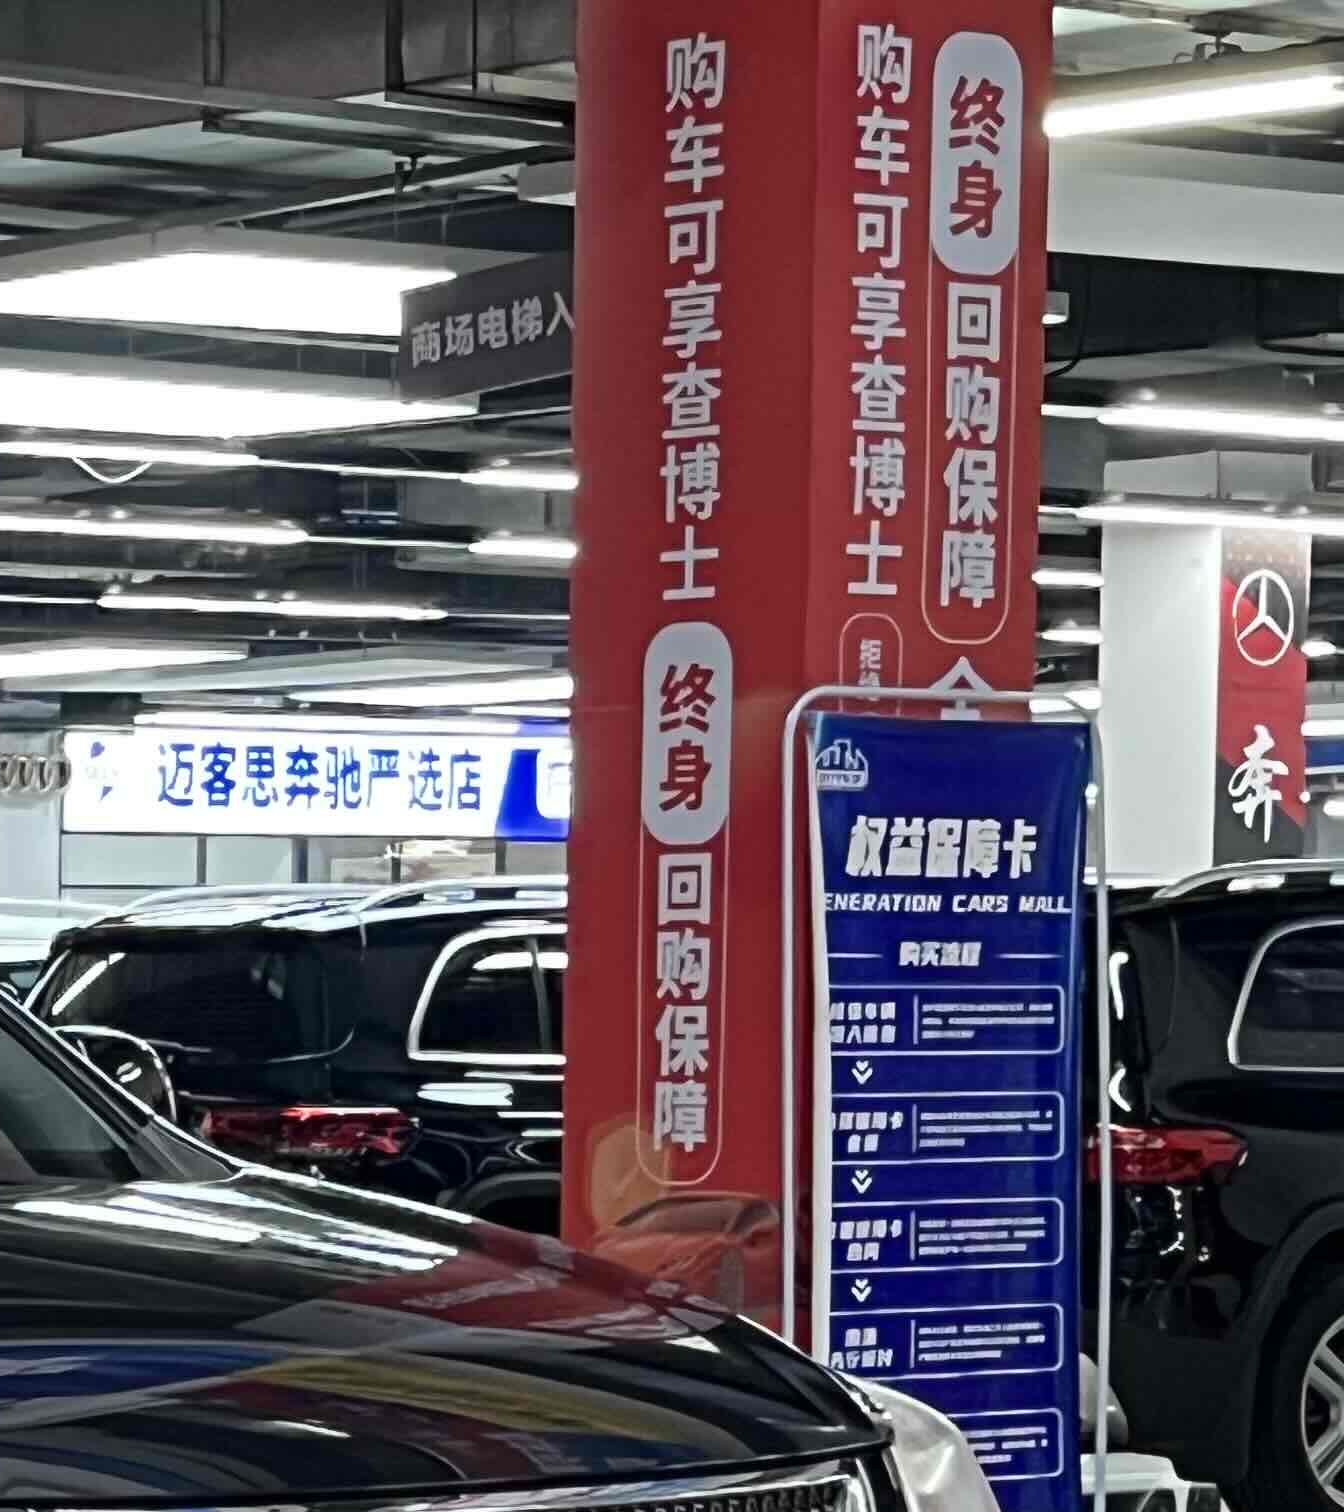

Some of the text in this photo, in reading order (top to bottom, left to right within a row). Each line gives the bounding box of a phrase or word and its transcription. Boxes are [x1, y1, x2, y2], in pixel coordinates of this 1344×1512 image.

[412, 291, 576, 368] 商场电梯入
[660, 31, 726, 602] 购车可享查博士
[847, 24, 912, 597] 购车可享查博士
[940, 75, 1007, 609] 终身 回购保障
[157, 742, 481, 811] 迈客思奔驰严选店
[653, 663, 717, 1153] 终身 回购保障
[951, 894, 1009, 913] CARS
[1018, 896, 1074, 914] MALL
